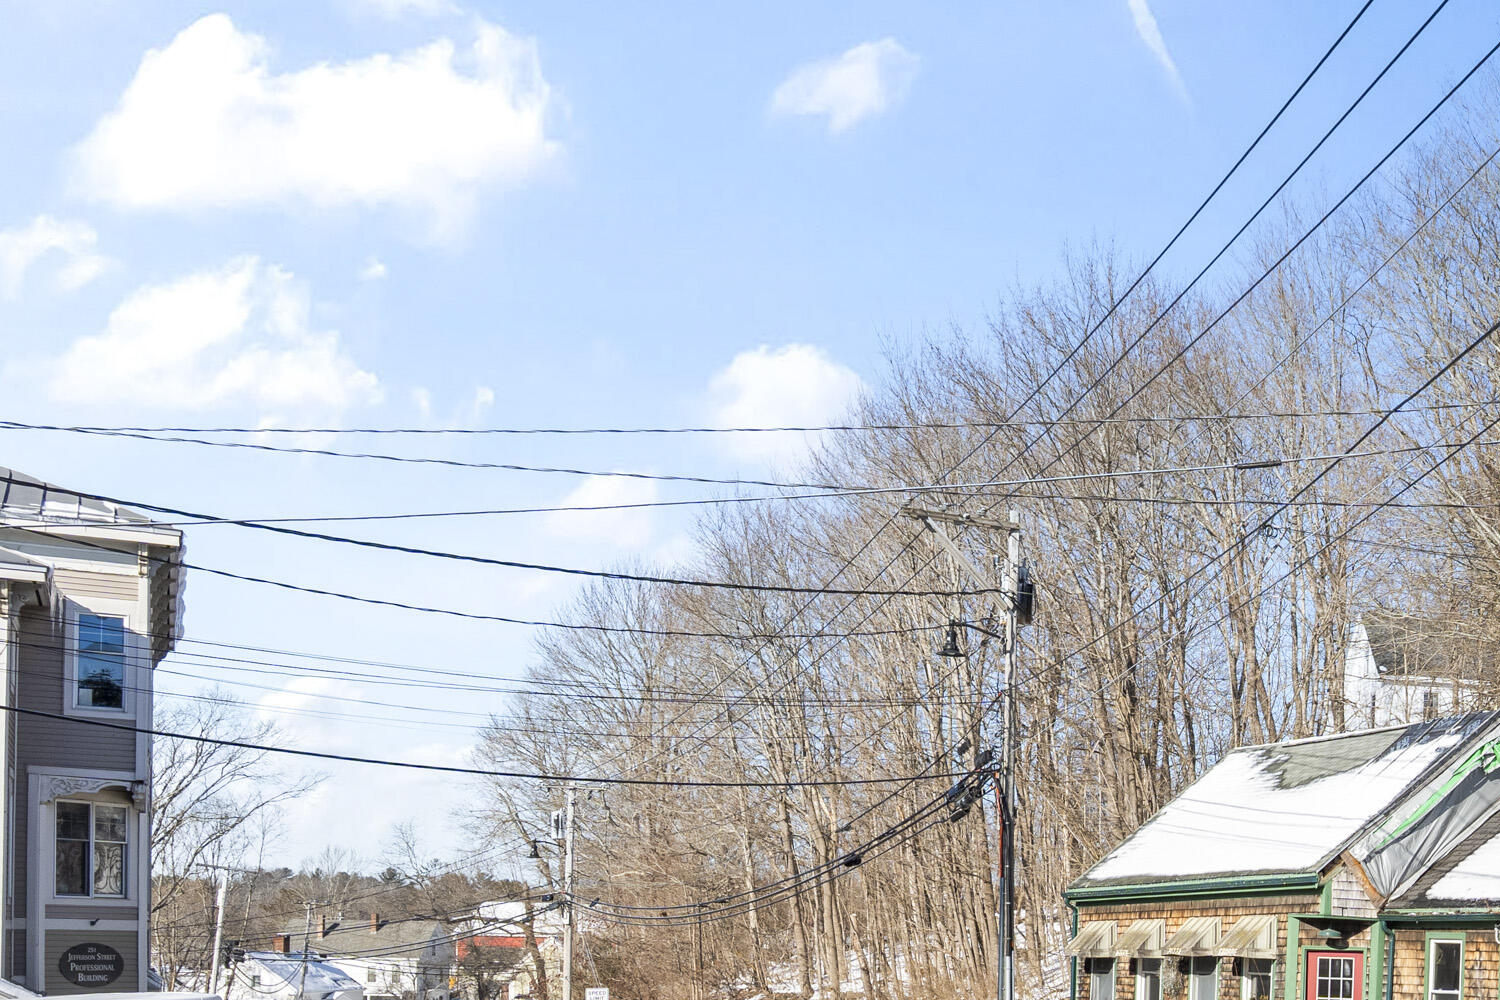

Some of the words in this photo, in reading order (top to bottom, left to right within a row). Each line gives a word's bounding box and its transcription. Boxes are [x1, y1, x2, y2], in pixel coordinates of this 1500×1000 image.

[68, 953, 95, 962] JEFFERSON
[96, 953, 116, 961] STREET
[70, 962, 115, 971] PROFESSIONAL
[78, 972, 108, 982] BUILDING
